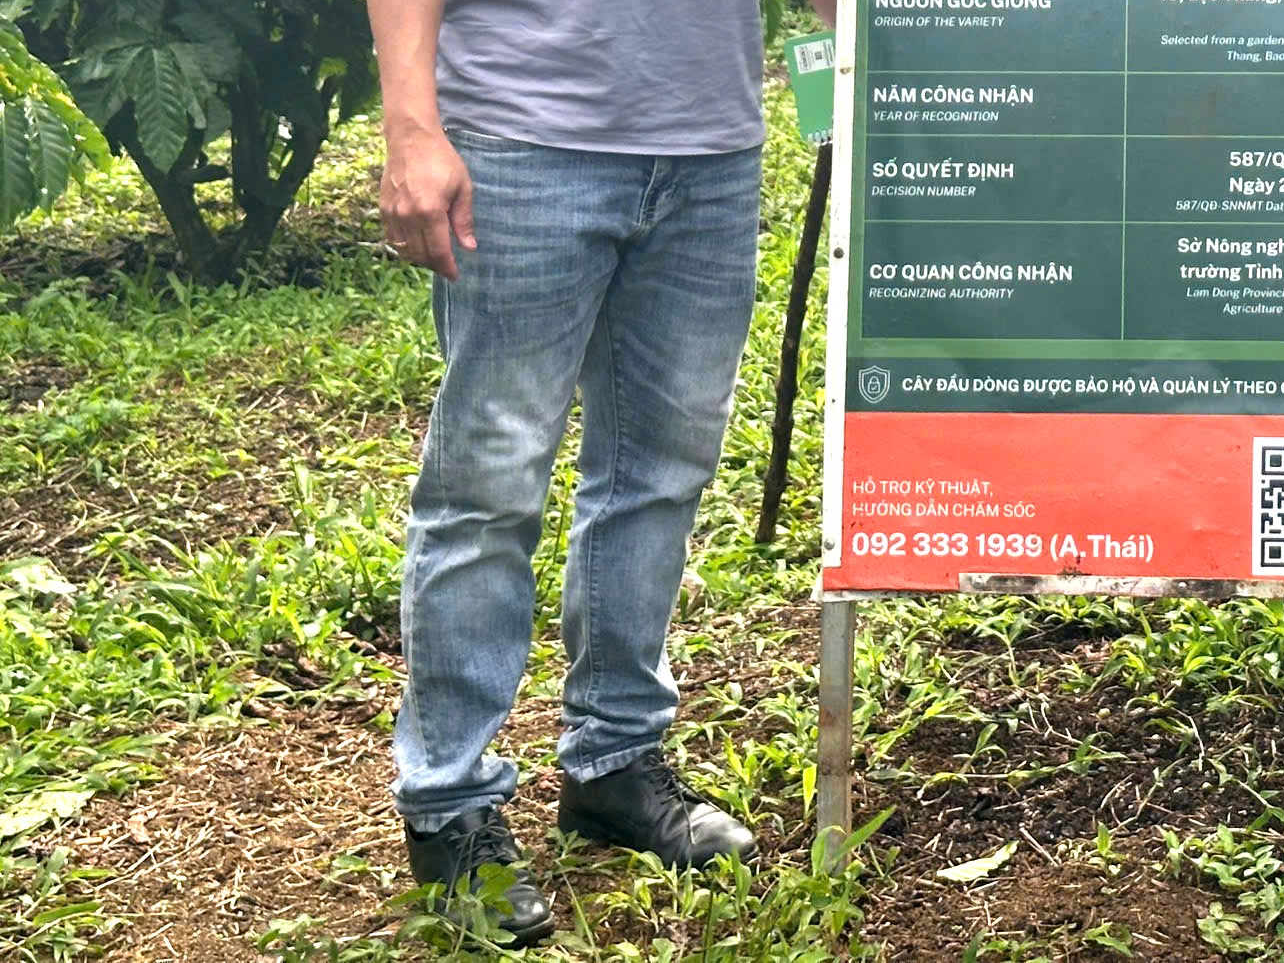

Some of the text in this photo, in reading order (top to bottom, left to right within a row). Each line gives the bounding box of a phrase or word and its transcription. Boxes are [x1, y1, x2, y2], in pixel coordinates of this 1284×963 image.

[875, 16, 1004, 27] ORIGIN OF THE VARIETY
[1161, 34, 1208, 45] Selected
[1211, 34, 1235, 45] from
[1238, 36, 1244, 45] a
[1247, 34, 1284, 47] garden
[1265, 50, 1284, 62] Bao
[874, 85, 1033, 106] NĂM CÔNG NHẬN
[874, 110, 999, 122] YEAR OF RECOGNITION
[873, 157, 1013, 181] SỐ QUYẾT ĐỊNH
[872, 185, 976, 197] DECISION NUMBER
[1230, 177, 1275, 195] Ngày
[1176, 200, 1263, 212] 587/QĐ-SNNMT
[1178, 237, 1202, 252] Sở
[1206, 238, 1252, 256] Nông
[870, 262, 1072, 284] CƠ QUAN CÔNG NHẬN
[1180, 264, 1241, 281] trường
[1245, 263, 1282, 279] Tỉnh
[869, 287, 1013, 299] RECOGNIZING AUTHORITY
[1187, 287, 1209, 297] Lam
[1213, 286, 1240, 300] Dong
[1223, 302, 1283, 316] Agriculture
[902, 375, 933, 391] CÂY
[936, 374, 969, 391] ĐẦU
[973, 376, 1019, 392] DÒNG
[1023, 379, 1071, 395] ĐƯỢC
[1076, 376, 1108, 392] BẢO
[1113, 377, 1135, 396] HỘ
[1139, 377, 1159, 393] VÀ
[1163, 376, 1209, 395] QUẢN
[1213, 378, 1230, 393] LÝ
[1233, 381, 1277, 394] THEO
[853, 476, 876, 493] HỖ
[880, 481, 911, 496] TRỢ
[916, 478, 934, 493] KỸ
[853, 499, 1035, 517] HƯỚNG DẪN CHĂM SÓC
[852, 532, 1153, 562] 092 333 1939 (A.Thái)
